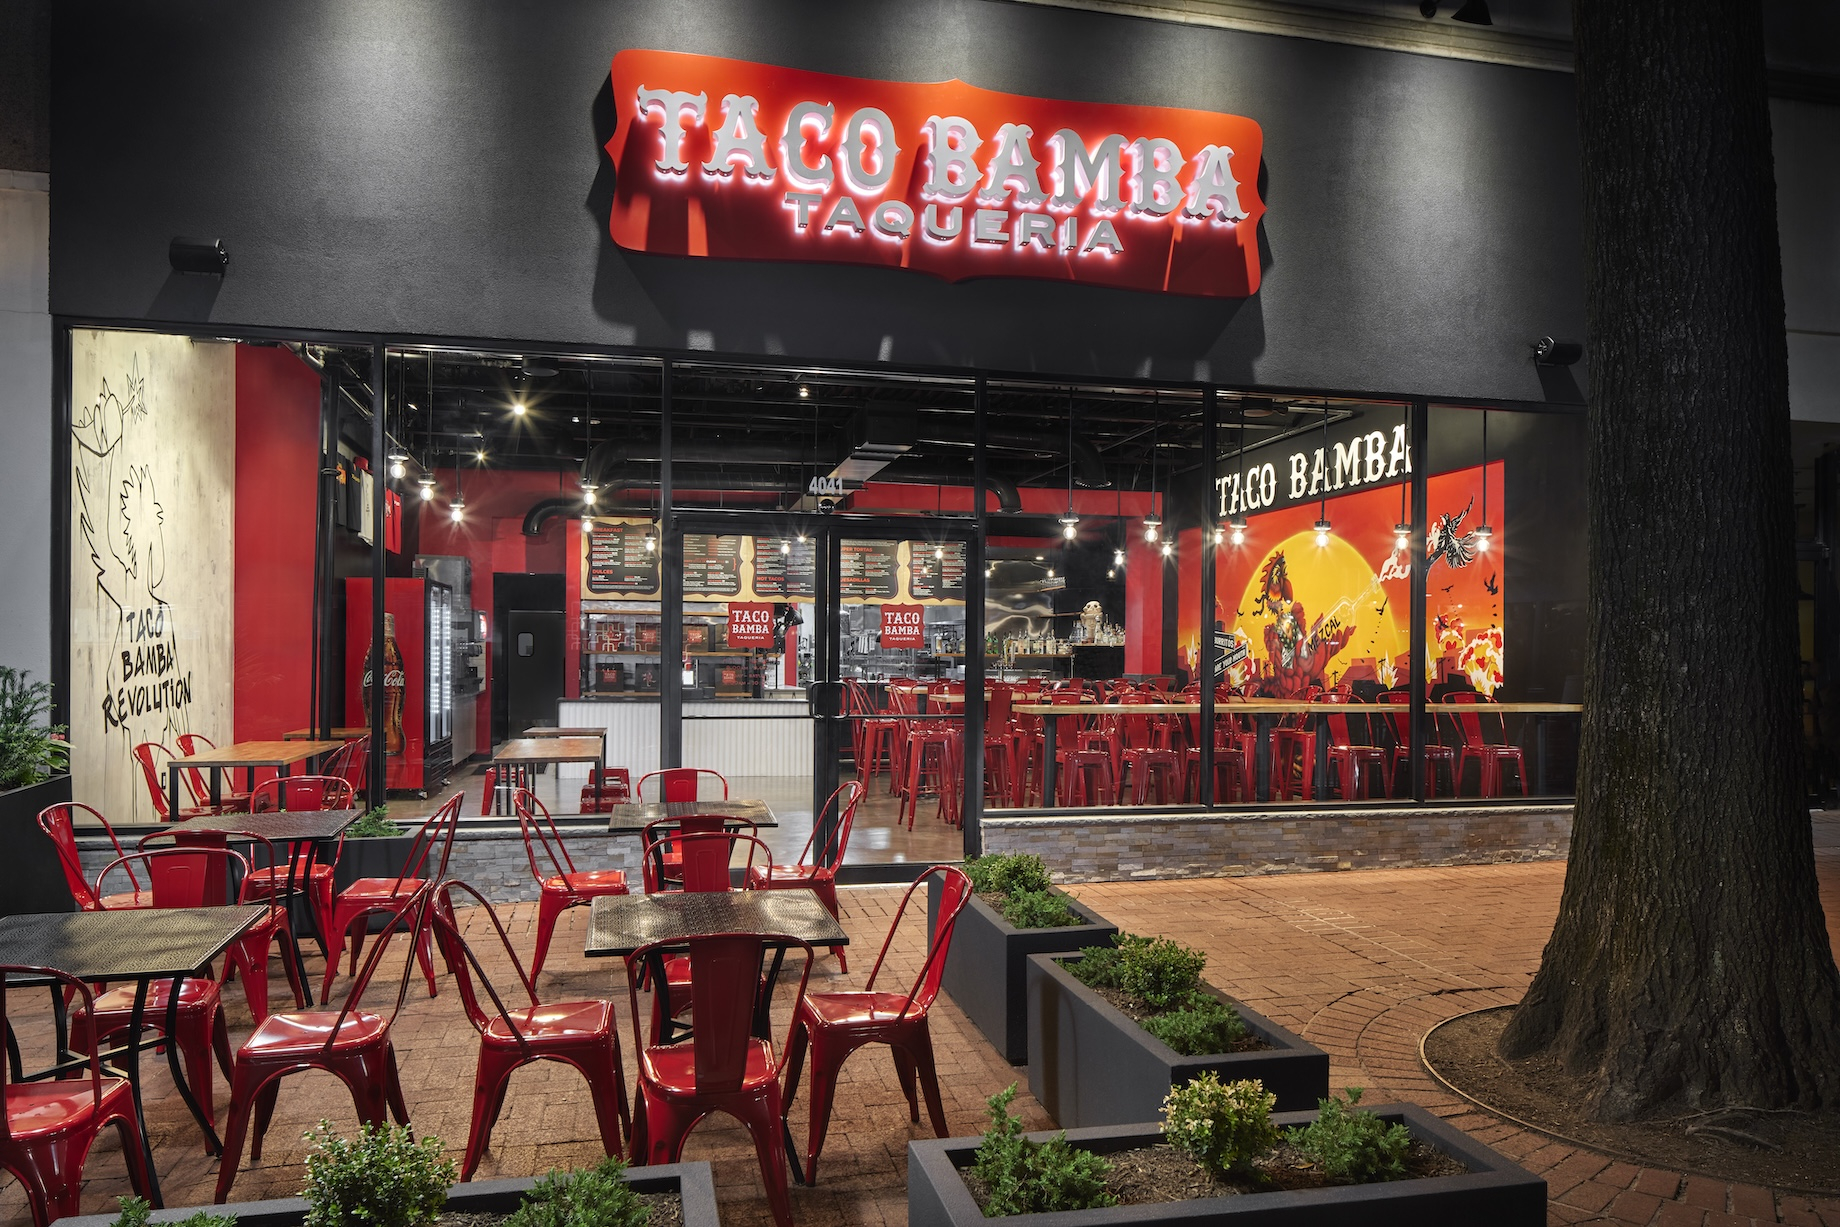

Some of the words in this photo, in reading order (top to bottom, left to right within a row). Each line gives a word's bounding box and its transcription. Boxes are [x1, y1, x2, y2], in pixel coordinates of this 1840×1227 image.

[637, 84, 902, 190] TACO
[920, 115, 1250, 222] BAMBA
[783, 192, 1124, 254] TAQUERIA
[1216, 463, 1278, 517] TACO
[1289, 424, 1412, 499] BAMBA
[809, 476, 843, 495] 4041
[126, 607, 164, 643] TACO
[732, 610, 769, 622] TACO
[732, 624, 770, 634] BAMBA
[884, 612, 920, 624] TACO
[884, 626, 920, 635] BAMBA
[1307, 615, 1341, 655] MEZCAL
[121, 641, 174, 682] BAMBA
[363, 669, 405, 687] CoCola
